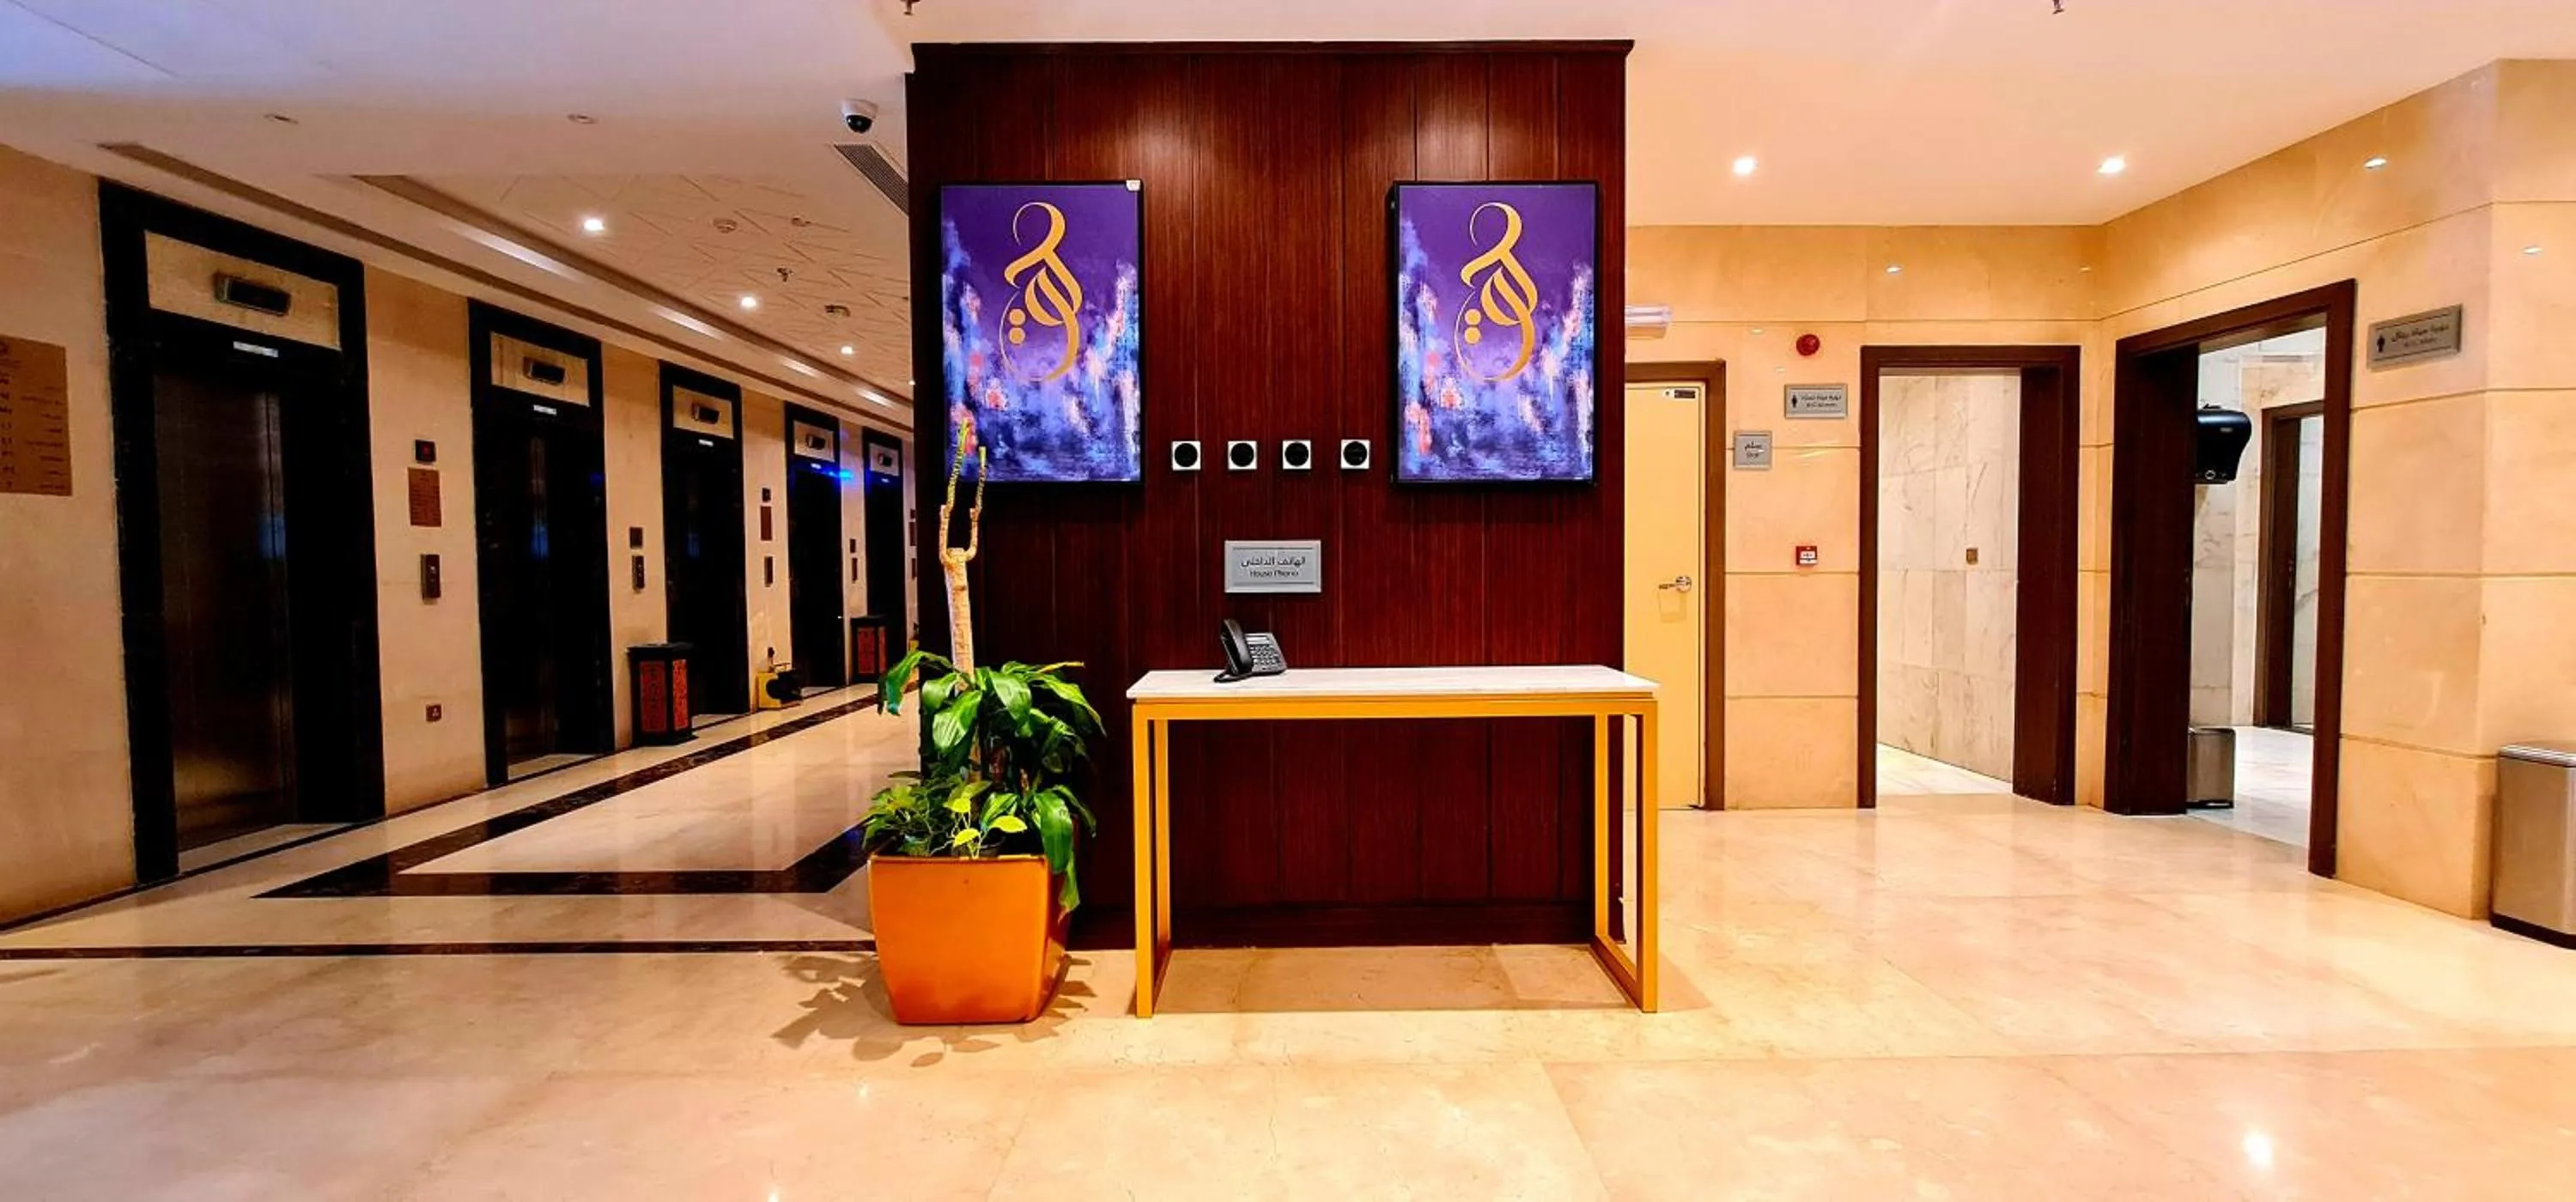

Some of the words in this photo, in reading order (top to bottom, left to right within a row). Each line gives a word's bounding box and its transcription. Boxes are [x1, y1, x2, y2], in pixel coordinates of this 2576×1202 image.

[1241, 555, 1275, 568] الداخلي
[1277, 555, 1306, 568] الهاتف
[1249, 569, 1273, 578] House
[1273, 569, 1300, 578] Phone
